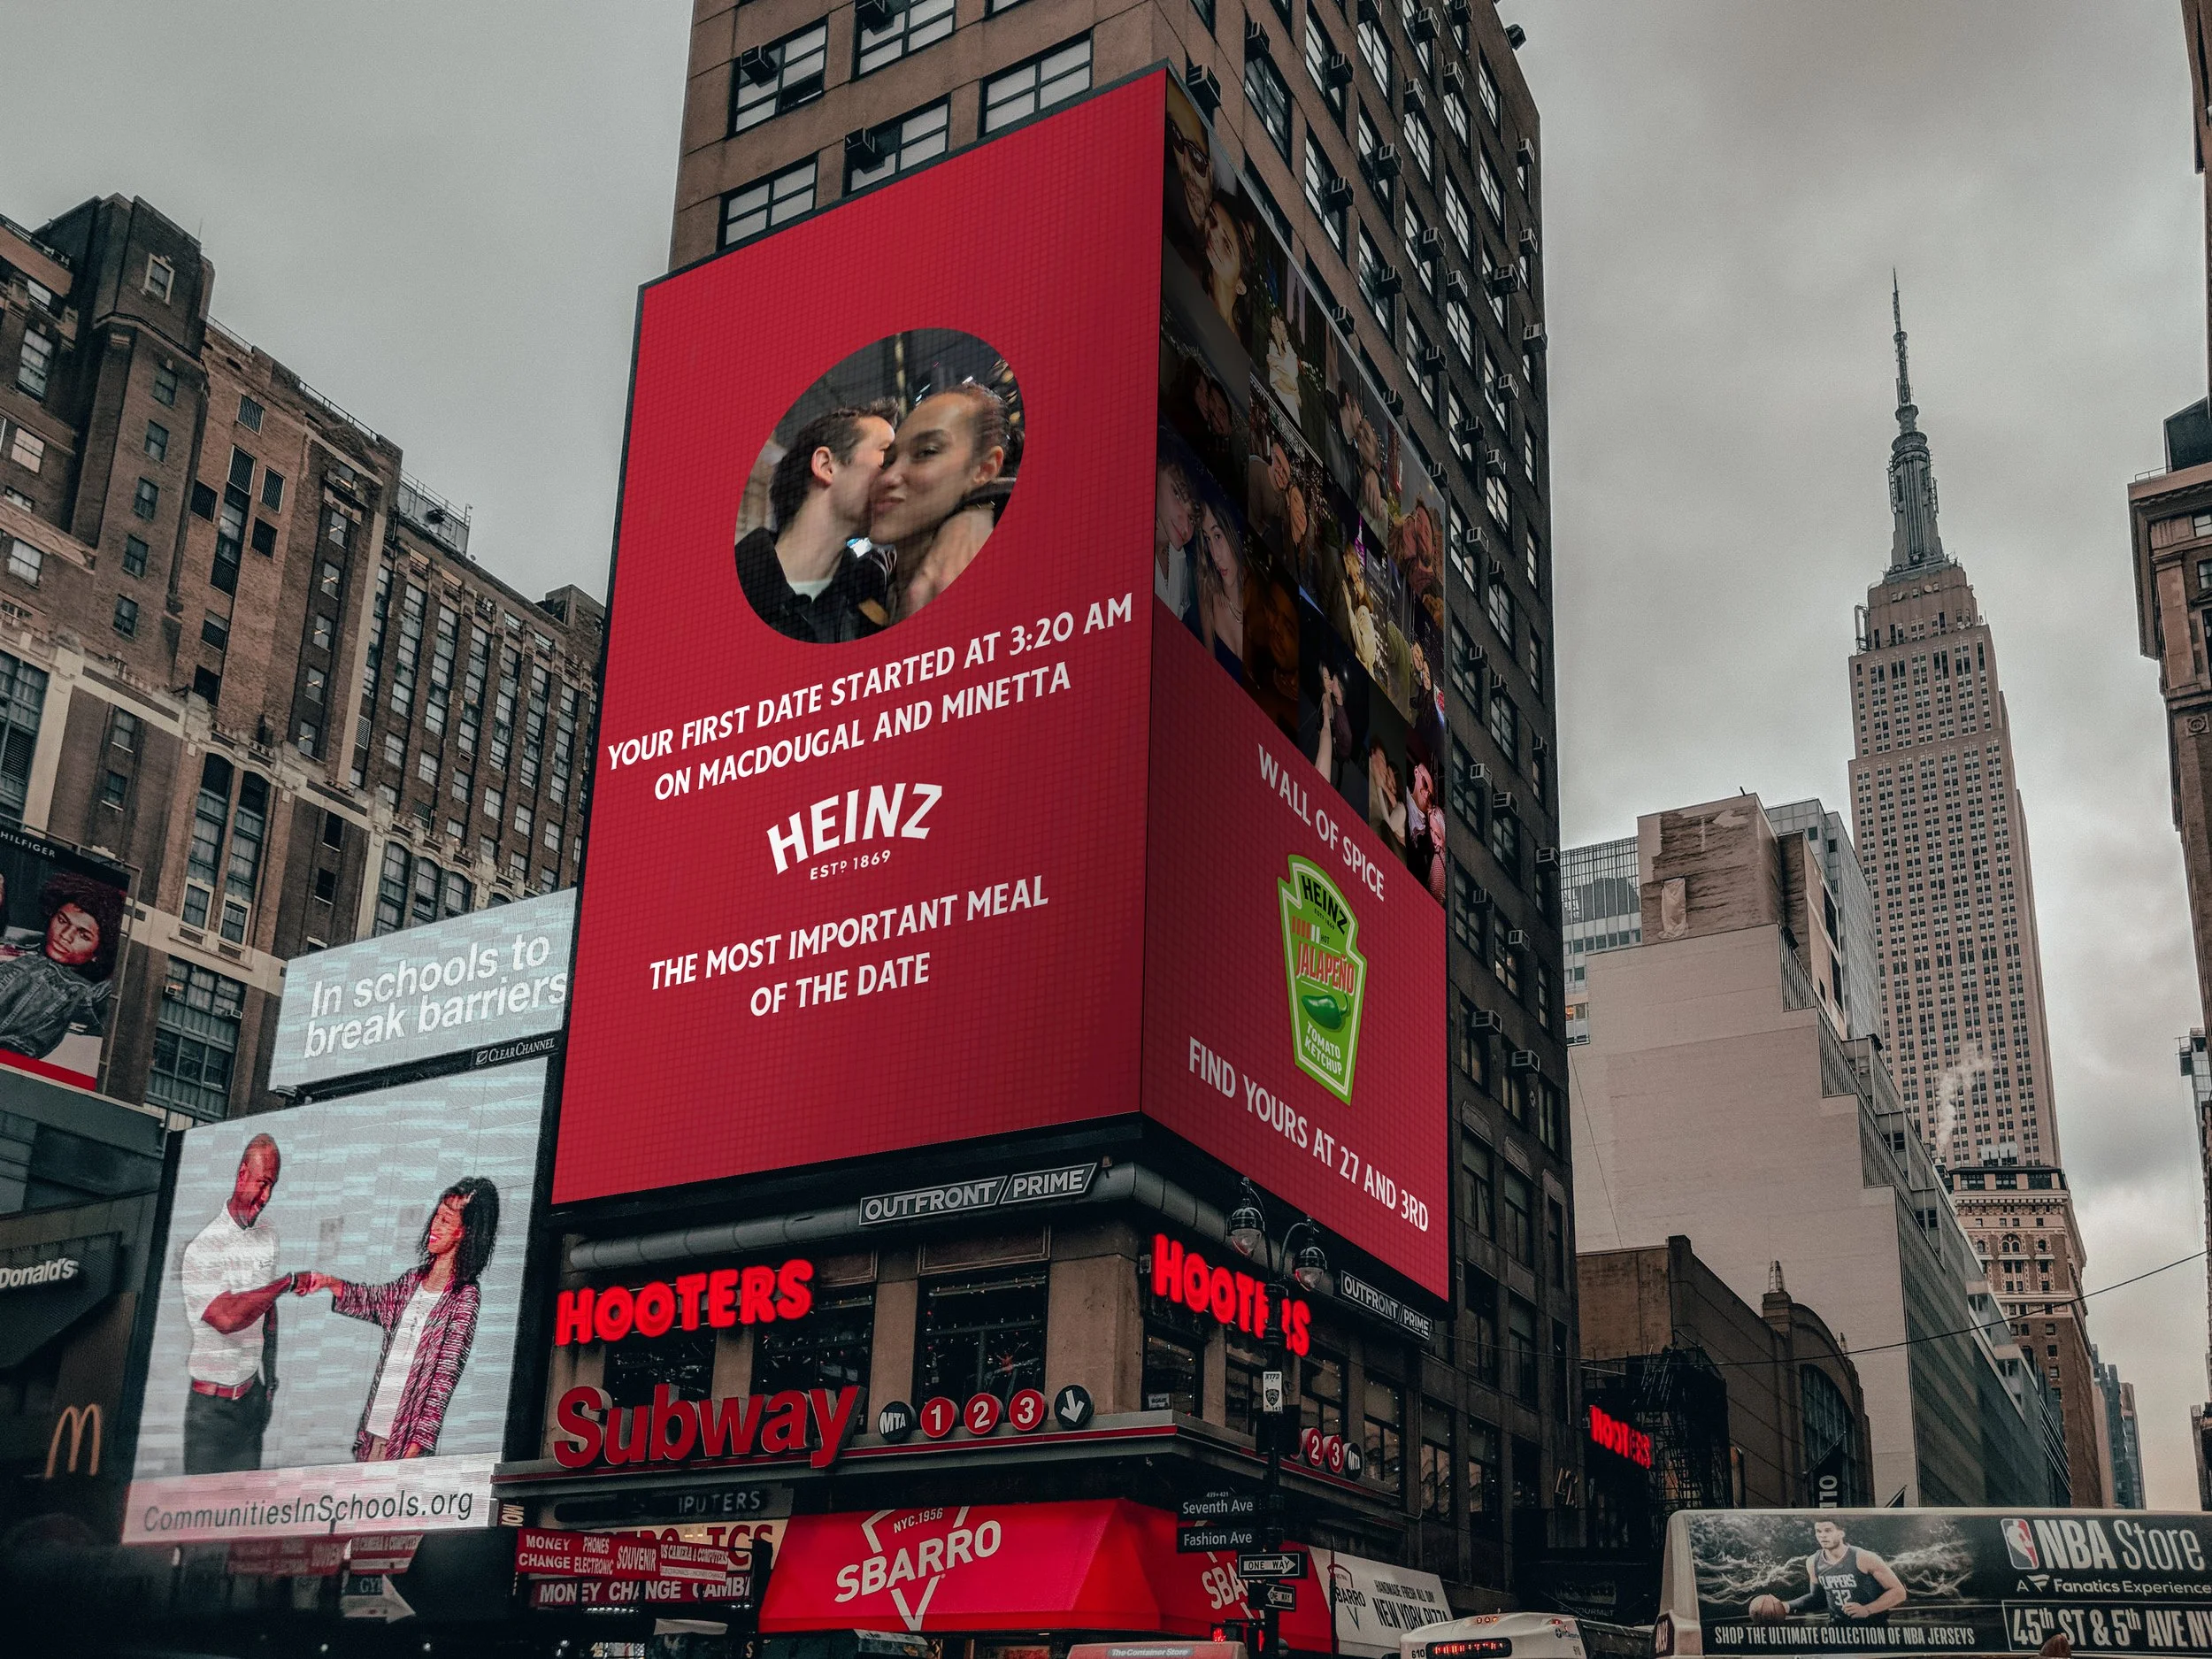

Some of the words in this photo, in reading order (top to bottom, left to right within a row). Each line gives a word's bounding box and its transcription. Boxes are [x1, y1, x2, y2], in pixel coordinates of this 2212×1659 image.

[608, 729, 673, 770] YOUR
[681, 705, 749, 749] FIRST
[757, 684, 824, 728] DATE
[831, 647, 956, 705] STARTED
[964, 632, 1002, 669] AT
[1009, 612, 1074, 656] 3:20
[1084, 593, 1133, 634] AM
[655, 766, 691, 801] ON
[698, 719, 865, 790] MACDOUGAL
[872, 701, 933, 742] AND
[941, 662, 1071, 724] MINETTA
[766, 782, 943, 875] HEINZ
[1257, 742, 1311, 827] WALL
[1316, 809, 1339, 851] OF
[1342, 835, 1385, 902] SPICE
[0, 831, 56, 857] HILFIGER
[852, 849, 892, 871] 1869
[1301, 875, 1348, 935] HEINZ
[649, 953, 699, 990] THE
[706, 934, 782, 979] MOST
[789, 895, 959, 961] IMPORTANT
[967, 875, 1049, 921] MEAL
[1320, 933, 1330, 945] HOT
[1325, 918, 1336, 931] 1869
[311, 979, 343, 1018] In
[353, 941, 499, 1007] schools
[512, 933, 550, 971] to
[750, 981, 788, 1017] OF
[795, 969, 849, 1009] THE
[857, 952, 931, 996] DATE
[1295, 941, 1356, 996] JALAPEÑO
[303, 1002, 408, 1059] break
[418, 972, 567, 1033] barriers
[1304, 1033, 1342, 1076] KETCHUP
[1307, 1020, 1341, 1059] TOMATO
[1189, 1036, 1236, 1099] FIND
[1243, 1073, 1308, 1149] YOURS
[1313, 1128, 1335, 1168] AT
[1340, 1145, 1360, 1185] 27
[1363, 1163, 1397, 1210] AND
[1401, 1188, 1429, 1233] 3RD
[864, 1181, 997, 1220] OUTFRONT
[1013, 1169, 1086, 1197] PRIME
[555, 1257, 815, 1347] HOOTERS
[1344, 1275, 1399, 1319] OUTFRONT
[1403, 1309, 1430, 1336] PRIME
[554, 1384, 862, 1469] Subway
[879, 1411, 906, 1433] MTA
[931, 1404, 941, 1431] 1
[973, 1401, 989, 1429] 2
[1018, 1397, 1034, 1424] 3
[1311, 1435, 1319, 1460] 2
[1332, 1442, 1340, 1466] 3
[1348, 1450, 1361, 1471] MTA
[144, 1489, 473, 1533] CommunitiesInSchools.org
[893, 1508, 943, 1533] NYC.1956
[1182, 1500, 1228, 1514] Seventh
[1232, 1499, 1254, 1512] Ave
[526, 1534, 572, 1551] MONEY
[583, 1536, 610, 1555] PHONES
[668, 1545, 693, 1562] CAMERA
[697, 1548, 729, 1565] COMPUTERS
[1184, 1532, 1227, 1547] Fashion
[1230, 1532, 1253, 1544] Ave
[2033, 1520, 2117, 1569] NBA
[2114, 1519, 2206, 1571] Store
[518, 1553, 571, 1569] CHANGE
[574, 1555, 614, 1575] ELECTRONIC
[616, 1545, 657, 1571] SOUVENIR
[834, 1520, 1002, 1602] SBARRO
[1248, 1561, 1264, 1570] ONE
[1272, 1560, 1290, 1570] WAY
[1334, 1586, 1366, 1608] BARRO
[1374, 1579, 1402, 1598] HANDMADE
[1402, 1586, 1416, 1600] FRESH
[1416, 1588, 1426, 1602] ALL
[1425, 1590, 1435, 1603] DAY
[2016, 1579, 2029, 1592] A
[2054, 1578, 2121, 1593] Fanatics
[2123, 1580, 2212, 1596] Experience
[1372, 1598, 1402, 1629] NEW
[1399, 1603, 1425, 1630] YORK
[2013, 1607, 2055, 1646] 45th
[2057, 1609, 2086, 1647] ST
[2090, 1609, 2113, 1647] &
[2111, 1607, 2142, 1647] 5th
[2146, 1610, 2188, 1647] AVE
[1126, 1647, 1166, 1656] Container
[1166, 1647, 1188, 1656] Store
[1412, 1648, 1425, 1659] 610
[1715, 1626, 1744, 1646] SHOP
[1746, 1626, 1767, 1646] THE
[1768, 1626, 1818, 1646] ULTIMATE
[1821, 1626, 1886, 1646] COLLECTION
[1887, 1626, 1901, 1646] OF
[1902, 1626, 1925, 1646] NBA
[1927, 1626, 1975, 1646] JERSEYS
